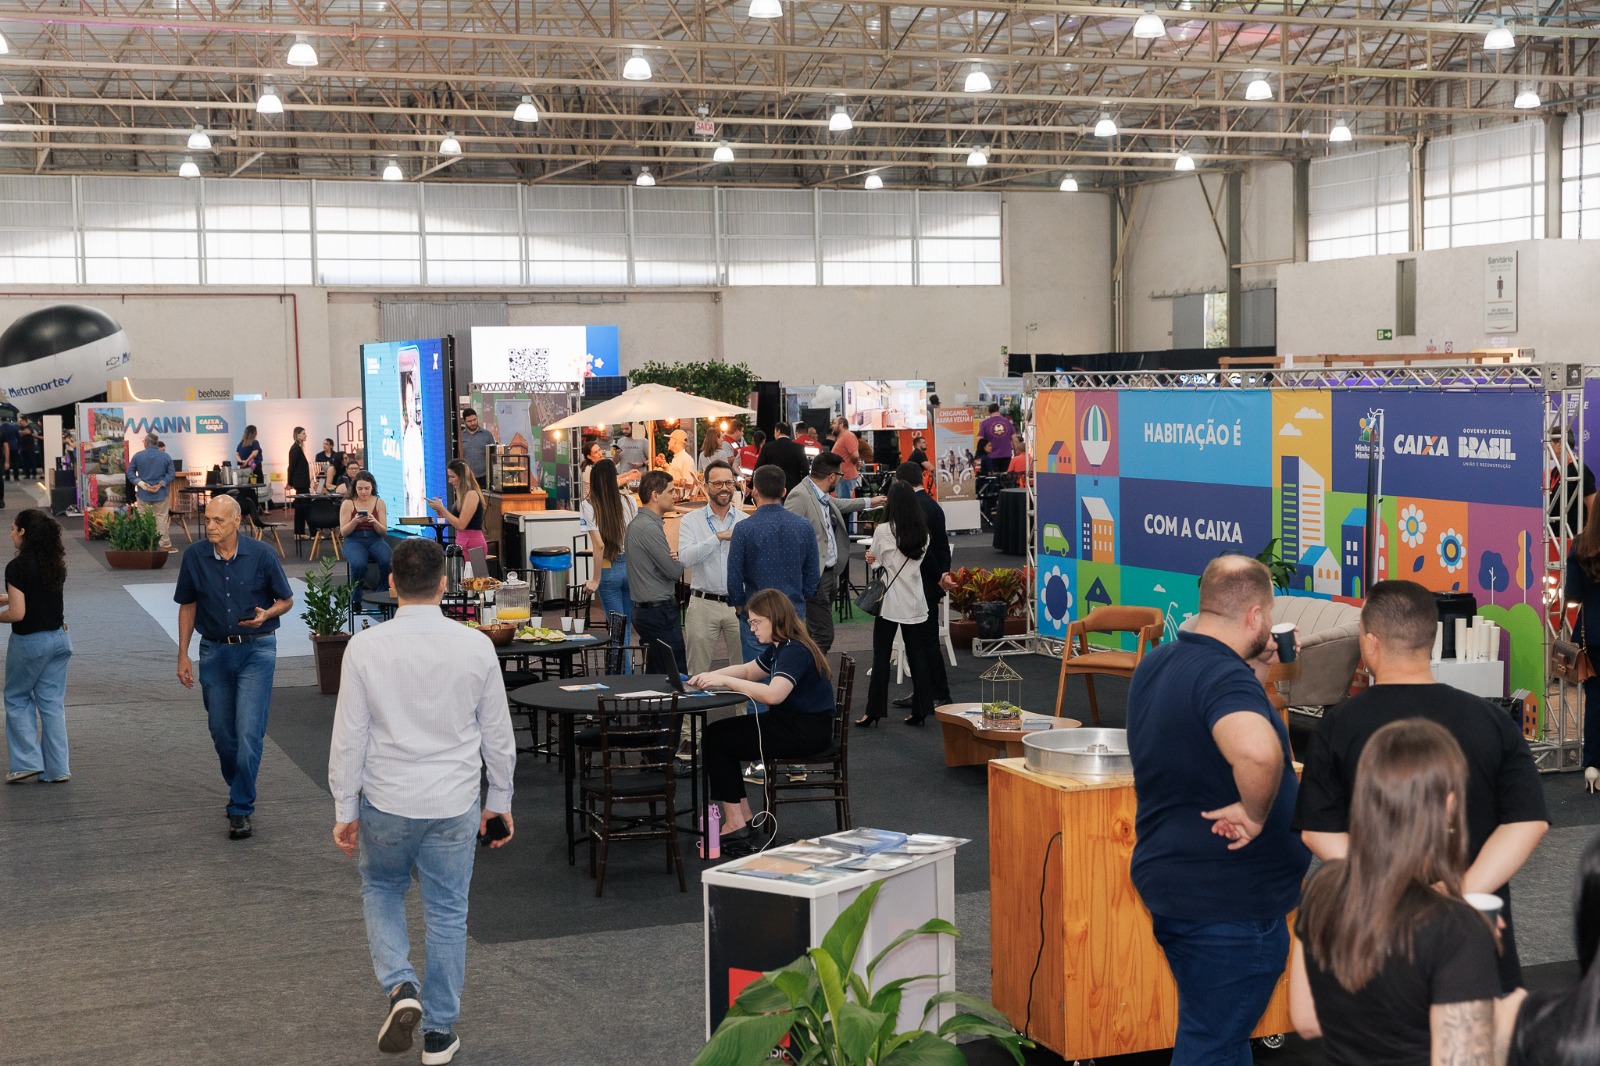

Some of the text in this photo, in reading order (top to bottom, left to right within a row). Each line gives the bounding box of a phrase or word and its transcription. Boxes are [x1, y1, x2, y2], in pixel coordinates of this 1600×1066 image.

[8, 377, 65, 398] Metronorte
[198, 388, 231, 398] beehouse
[1144, 418, 1241, 450] HABITAÇÃO É
[1393, 434, 1449, 456] CAIXA
[1458, 436, 1516, 460] BRASIL
[1144, 513, 1243, 544] COM A CAIXA
